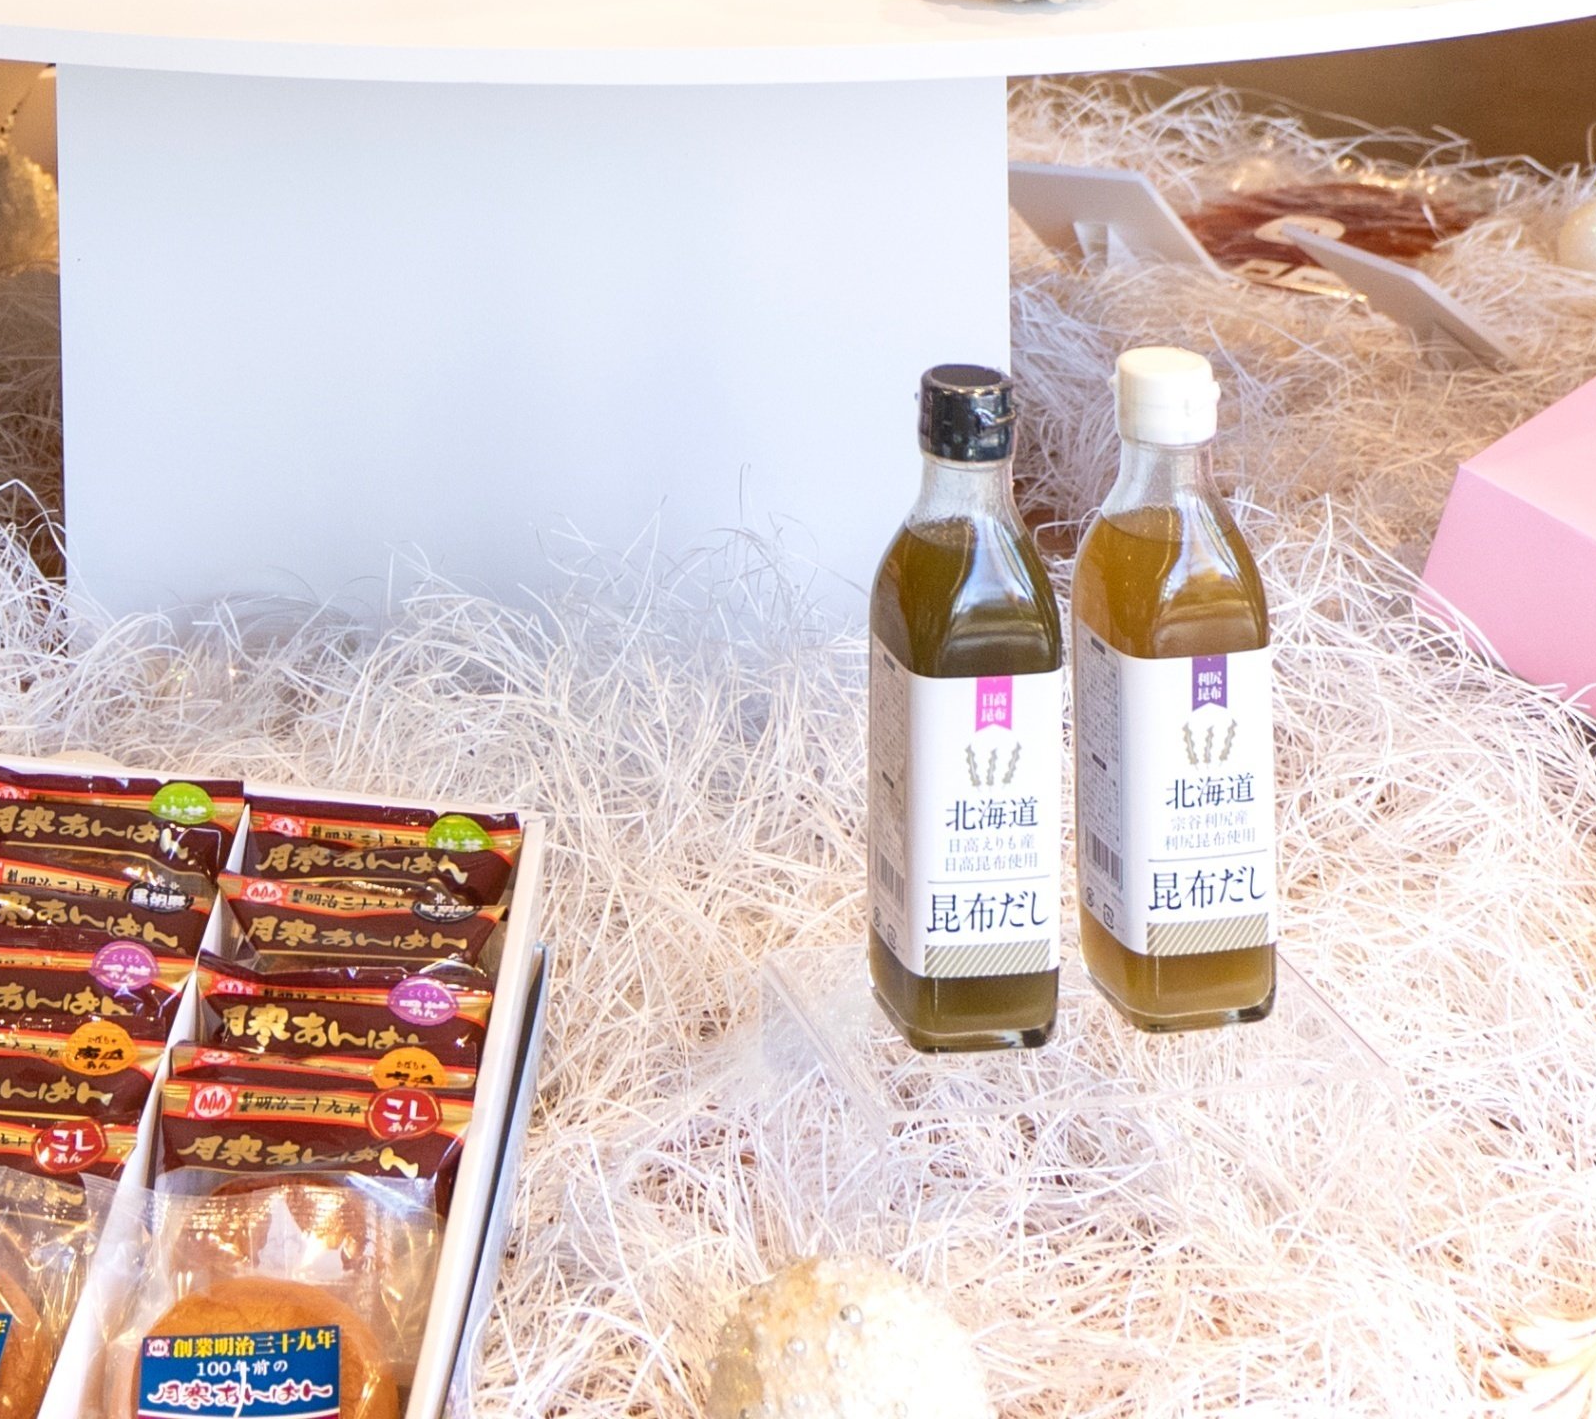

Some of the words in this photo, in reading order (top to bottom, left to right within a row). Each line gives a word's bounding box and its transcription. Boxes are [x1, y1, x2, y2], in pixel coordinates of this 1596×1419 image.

[1198, 671, 1222, 687] 利尻
[981, 692, 1007, 708] 日高
[1198, 685, 1222, 701] 昆布
[981, 709, 1007, 723] 昆布
[1165, 772, 1255, 811] 北海道
[945, 796, 1039, 832] 北海道
[1170, 810, 1248, 831] 宗谷利尻産
[949, 833, 1035, 854] 日高えりも産
[1163, 826, 1255, 852] 利尻昆布使用
[255, 843, 469, 885] 月寒あんぱん
[944, 852, 1038, 873] 日高昆布使用
[1148, 865, 1268, 912] 昆布だし
[926, 890, 1049, 934] 昆布だし
[247, 916, 469, 951] 月寒あんぱん
[256, 1095, 361, 1117] 明治三十九年
[384, 1098, 428, 1122] こし
[388, 1121, 418, 1133] あん
[51, 1128, 95, 1152] こし
[52, 1152, 83, 1164] あん
[177, 1133, 419, 1179] 月寒あんぱん
[173, 1329, 336, 1358] 創業明治三十九年
[196, 1359, 288, 1377] 100年前の
[147, 1378, 334, 1410] 月寒あんぱん
